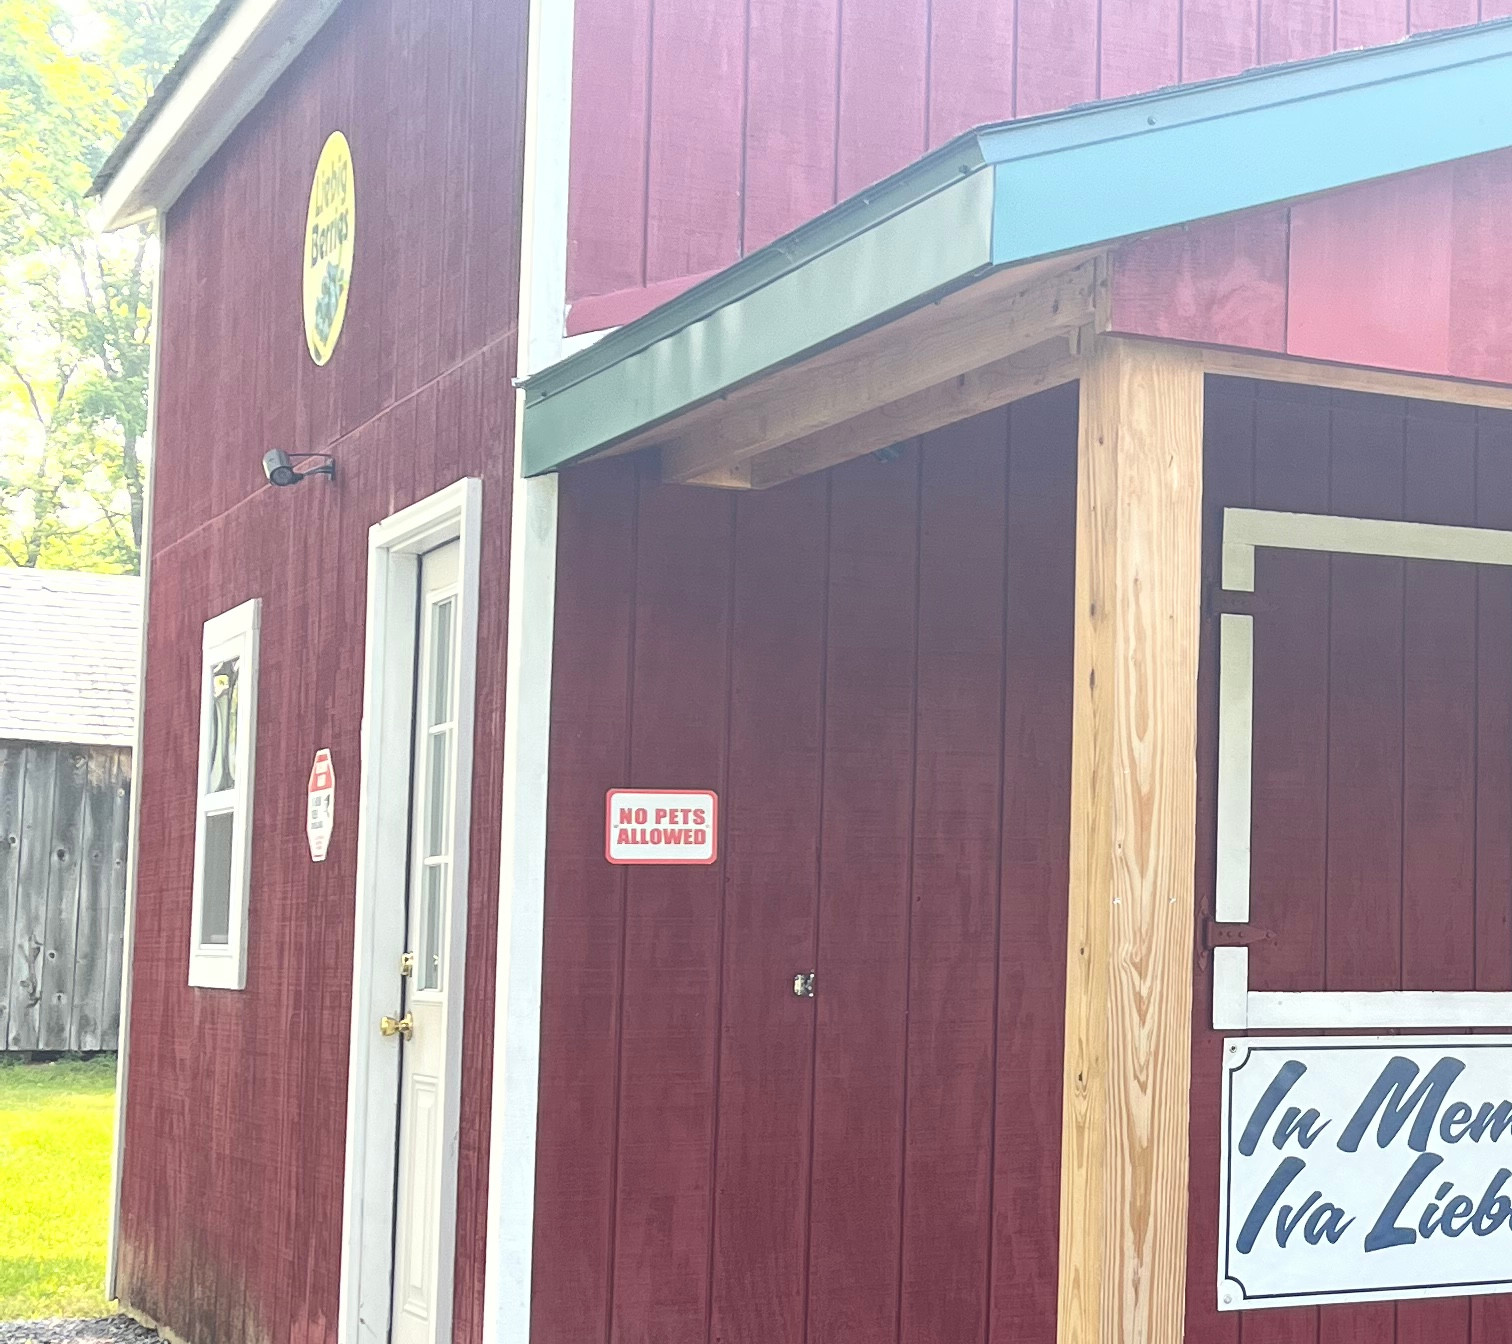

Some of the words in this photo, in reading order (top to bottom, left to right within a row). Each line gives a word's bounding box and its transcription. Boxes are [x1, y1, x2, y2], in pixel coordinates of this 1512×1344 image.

[315, 153, 347, 218] Liebig
[311, 206, 349, 268] Berries
[616, 827, 707, 845] ALLOWED
[618, 807, 648, 825] NO
[654, 808, 706, 825] PETS
[1238, 1059, 1332, 1157] In
[1236, 1156, 1356, 1254] Iva
